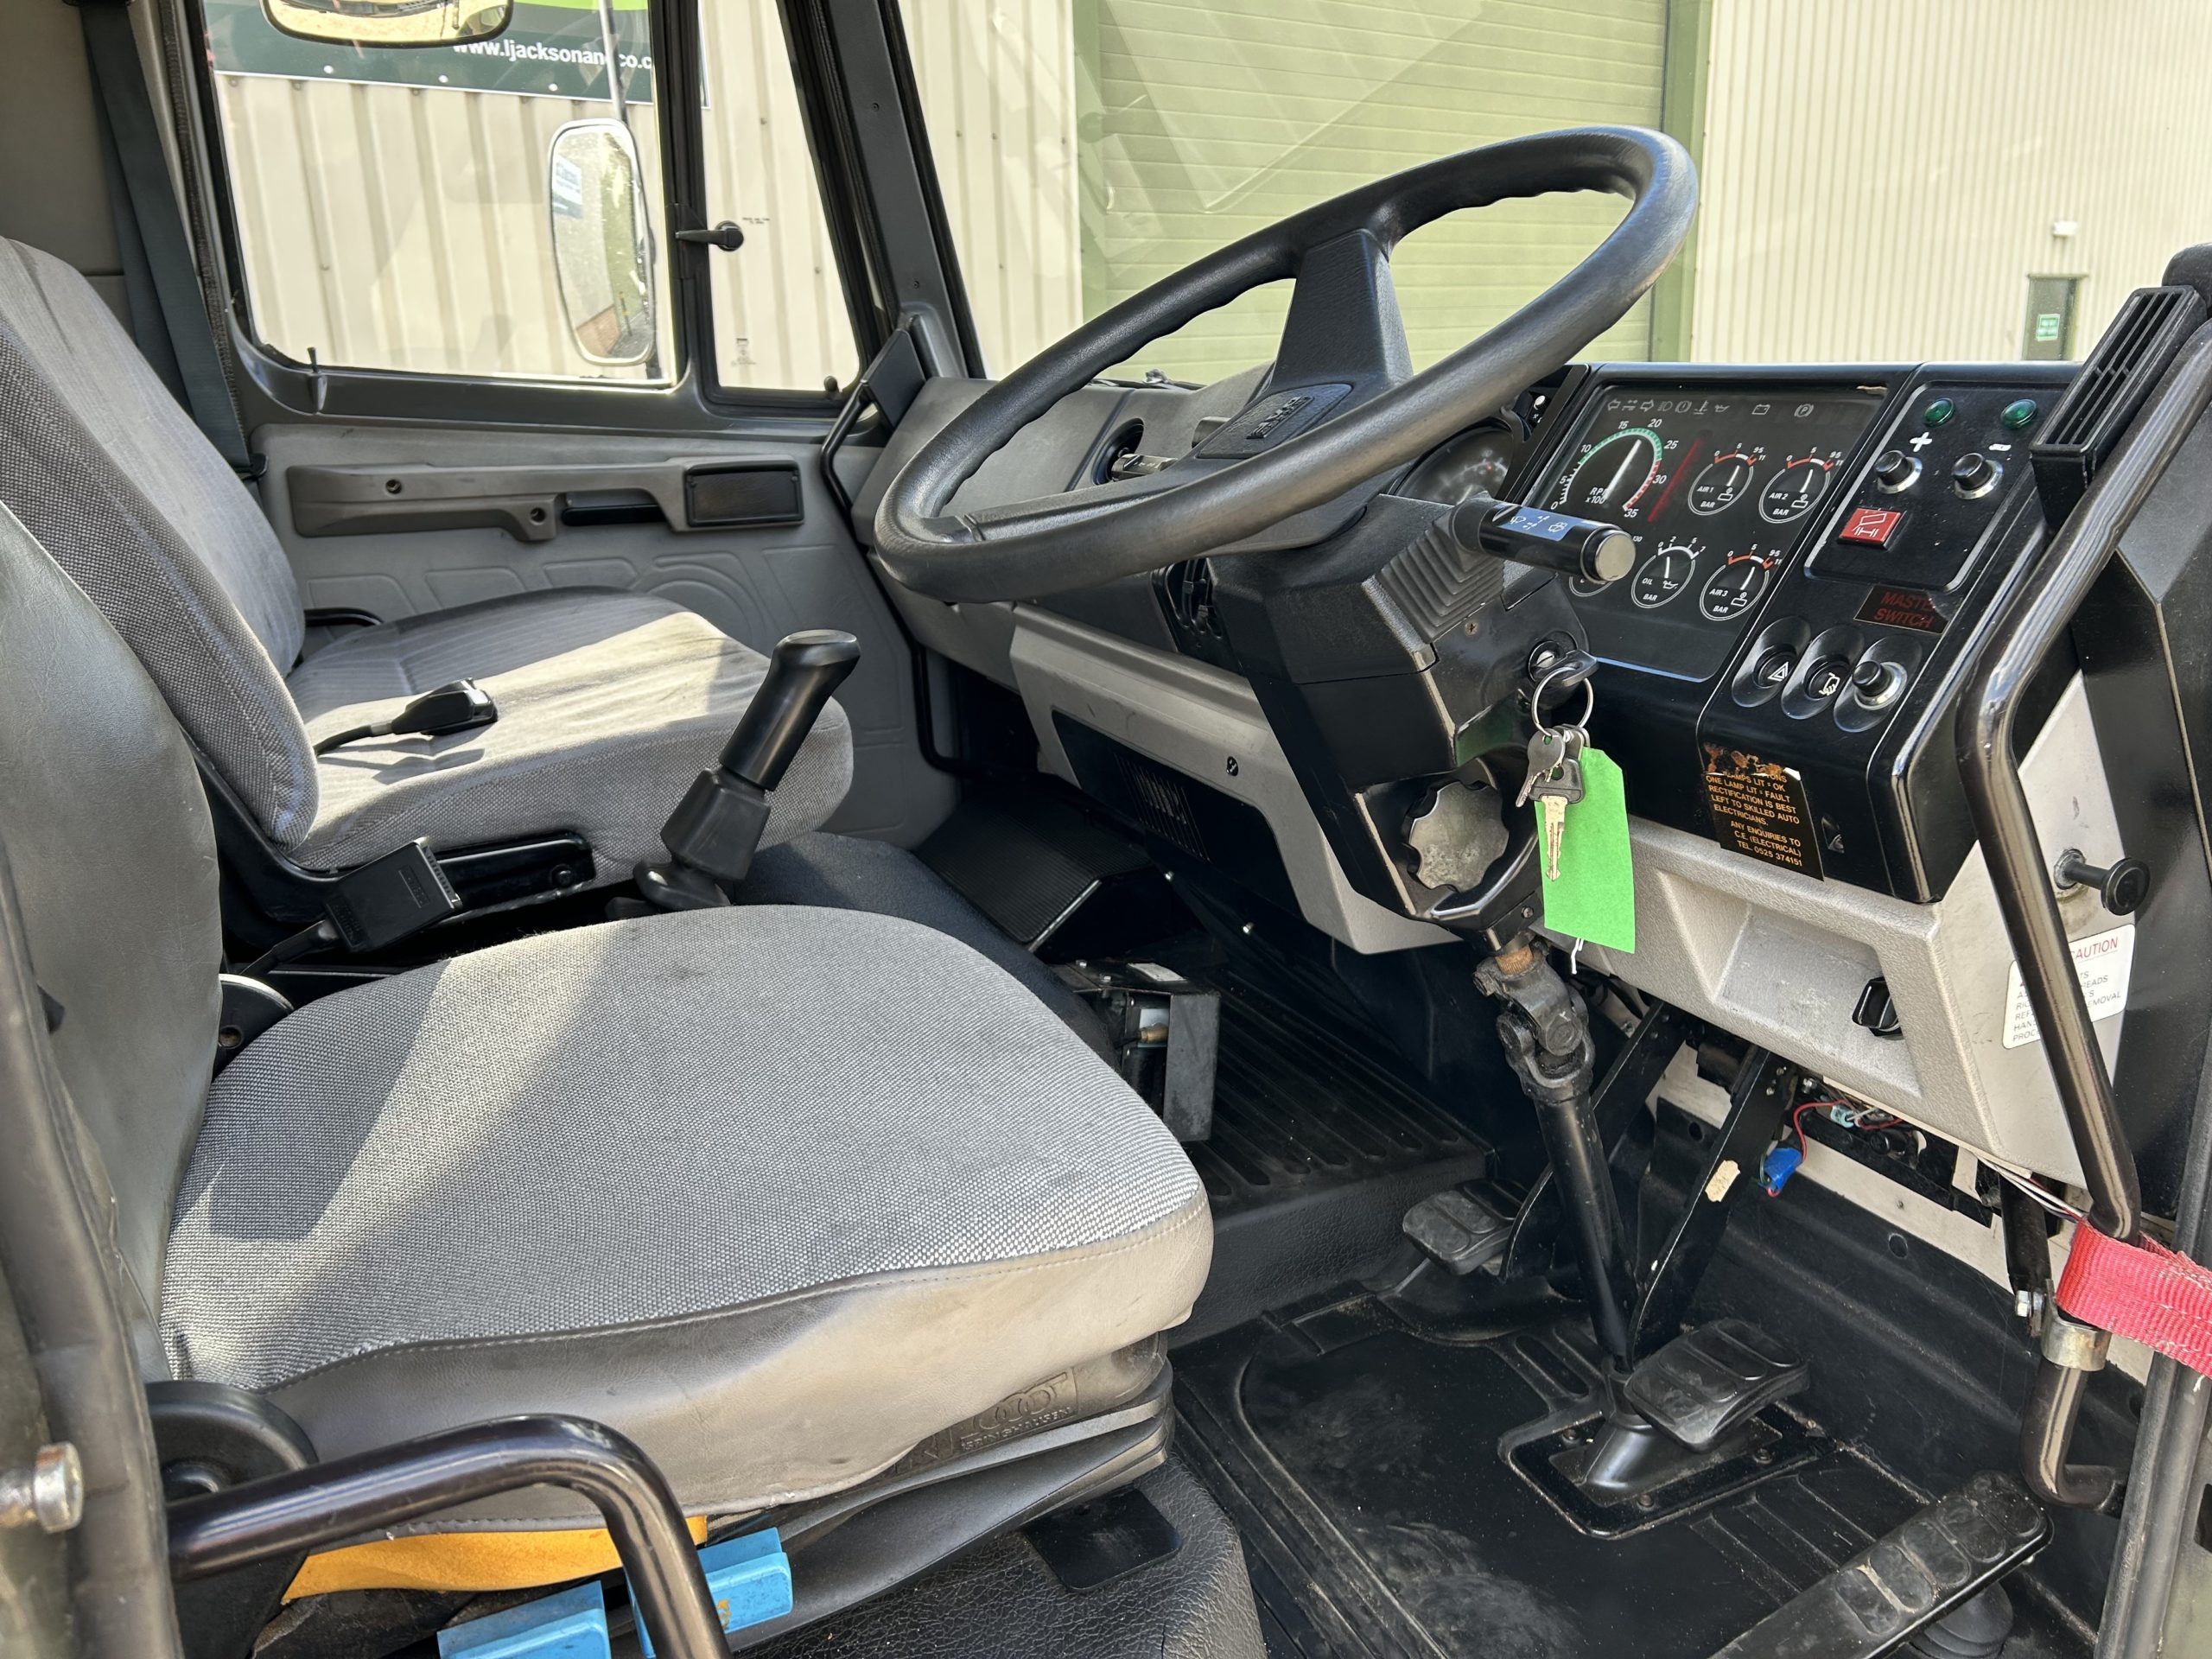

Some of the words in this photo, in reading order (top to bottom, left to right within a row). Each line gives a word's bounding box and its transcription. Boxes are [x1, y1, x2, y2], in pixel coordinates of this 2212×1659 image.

[1618, 420, 1630, 430] 15
[1647, 418, 1662, 429] 20
[1580, 444, 1592, 453] 10
[1663, 440, 1679, 449] 25
[1652, 474, 1667, 484] 30
[1590, 486, 1605, 496] RP
[1550, 501, 1559, 510] 0
[1585, 495, 1605, 505] x100
[1624, 508, 1639, 518] 35
[1643, 593, 1658, 601] BAR
[1709, 588, 1722, 596] AIR
[1880, 590, 1935, 613] MASTE
[1713, 605, 1729, 613] BAR
[1873, 607, 1936, 628] SWITCH
[1706, 775, 1724, 785] ONE
[1724, 779, 1745, 791] LAMP
[1746, 785, 1758, 795] LIT
[1764, 791, 1790, 803] FAULT
[1753, 778, 1765, 787] LIT
[1772, 782, 1786, 791] OK
[1708, 785, 1764, 805] RECTIFICATION
[1765, 799, 1774, 808] IS
[1776, 802, 1796, 814] BEST
[1711, 794, 1729, 804] LEFT
[1731, 799, 1742, 808] TO
[1744, 804, 1775, 817] SKILLED
[1777, 813, 1800, 824] AUTO
[1713, 804, 1769, 826] ELECTRICIANS.
[1731, 820, 1745, 830] ANY
[1747, 824, 1788, 843] ENQUIRIES
[1789, 837, 1802, 848] TO
[1750, 836, 1802, 857] (ELECTRICAL)
[1754, 846, 1774, 858] 0525
[1776, 853, 1802, 867] 374151
[2087, 991, 2121, 1008] EMOVAL
